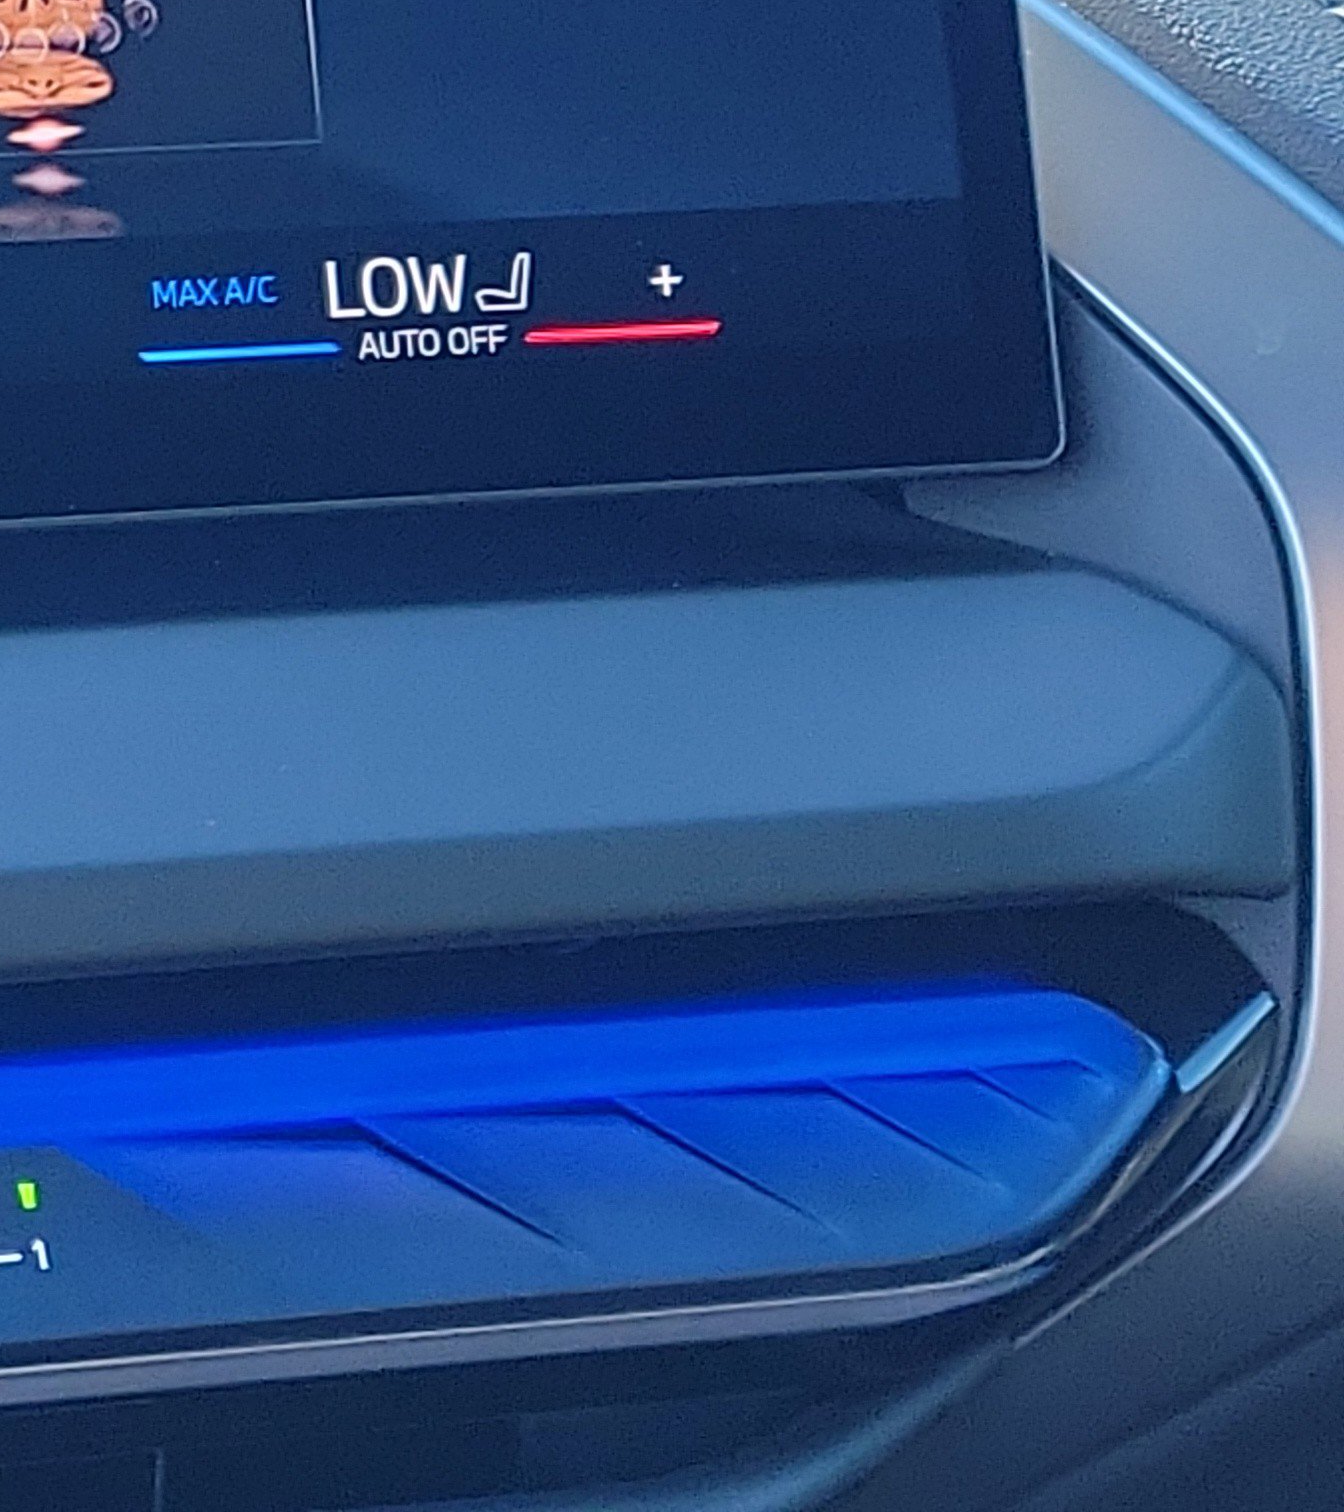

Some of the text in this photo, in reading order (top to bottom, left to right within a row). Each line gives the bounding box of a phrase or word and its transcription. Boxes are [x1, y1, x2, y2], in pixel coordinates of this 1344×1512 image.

[151, 275, 278, 309] MAX A/C
[324, 253, 468, 320] LOW
[357, 324, 509, 361] AUTO OFF
[30, 1240, 50, 1272] 1
